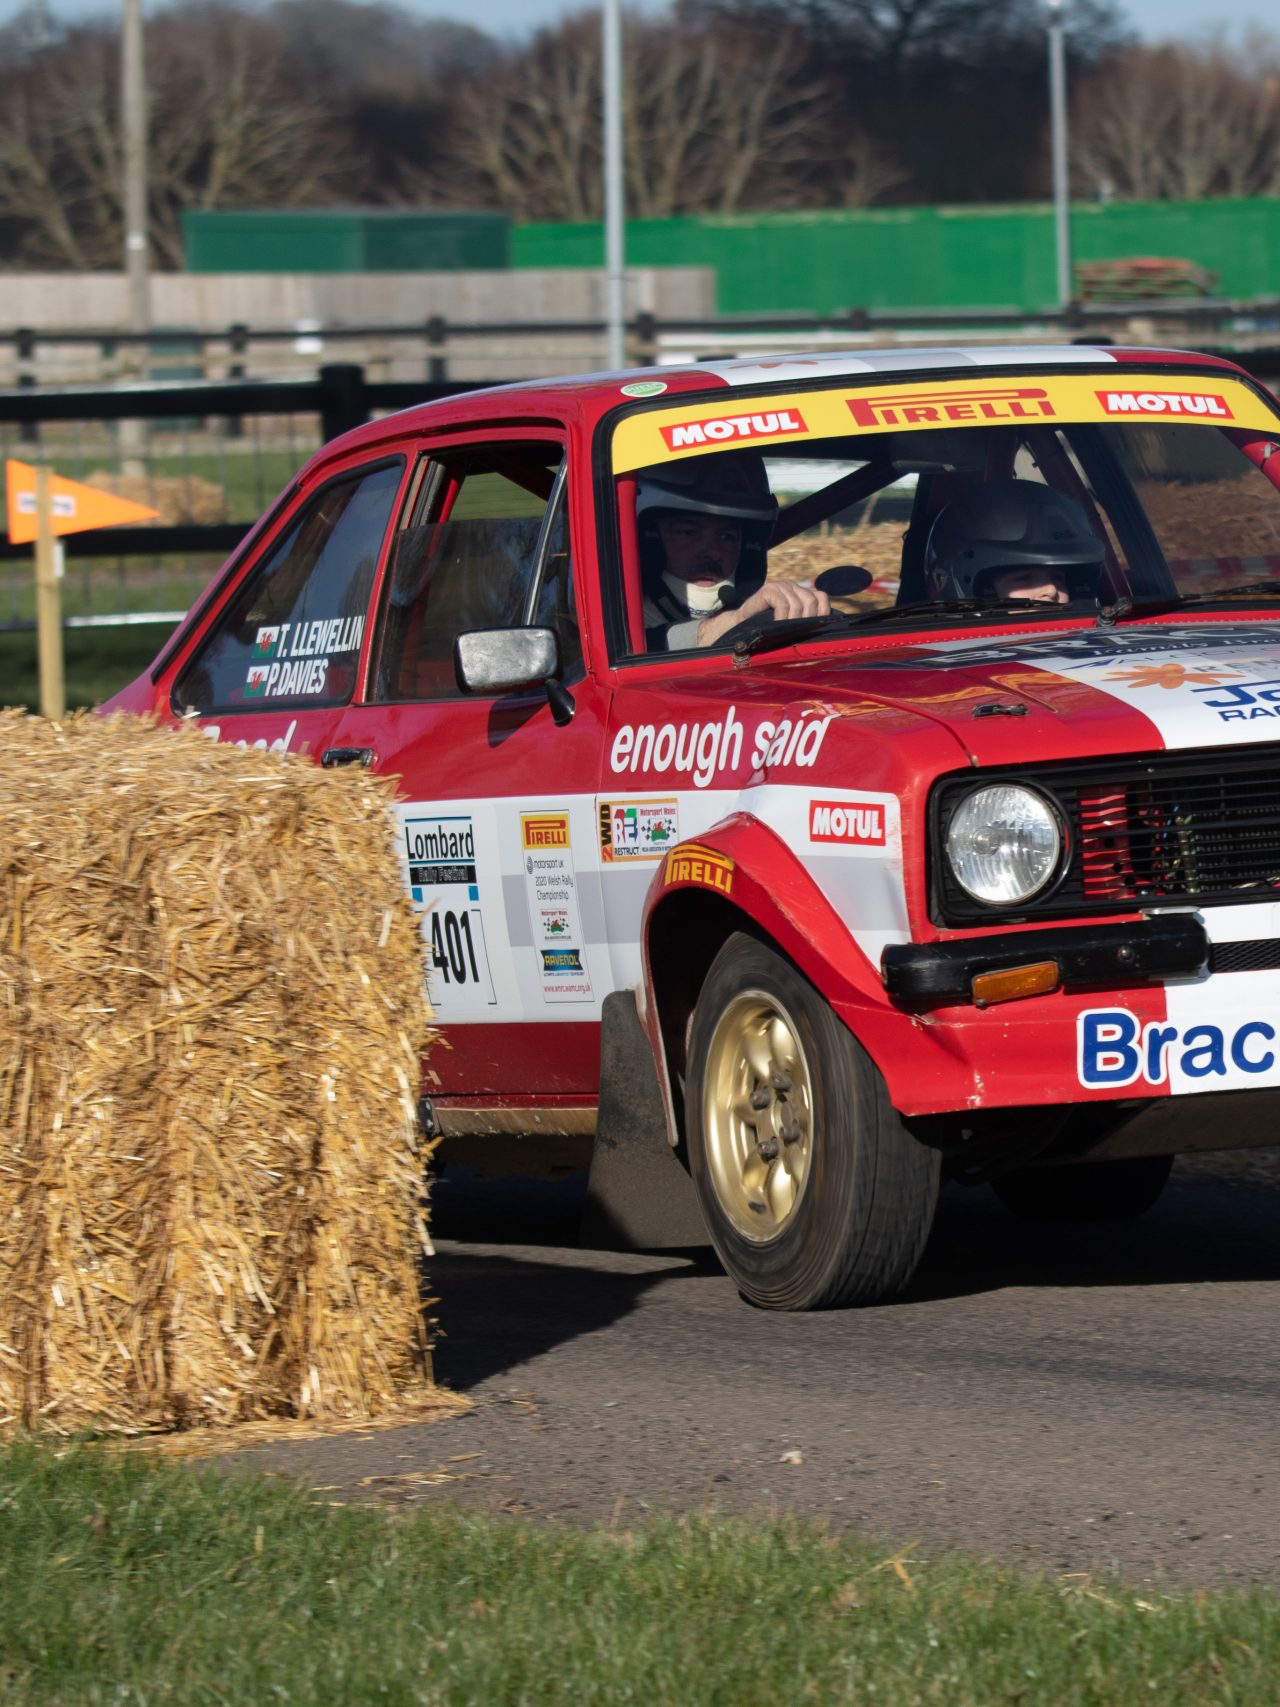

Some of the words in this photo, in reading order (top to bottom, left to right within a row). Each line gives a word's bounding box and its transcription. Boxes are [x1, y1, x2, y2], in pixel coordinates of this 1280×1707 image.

[845, 387, 1056, 427] PIRELLI
[1107, 391, 1226, 417] MOTUL
[671, 411, 799, 448] MOTUL
[277, 624, 290, 658] T.
[290, 615, 366, 657] LLEWELLIN
[610, 704, 744, 788] enough
[751, 708, 842, 771] said
[405, 823, 475, 860] Lombard
[525, 819, 567, 846] PIRELLI
[811, 806, 883, 840] MOTUL
[664, 844, 736, 894] PIRELLI
[432, 910, 480, 985] 401
